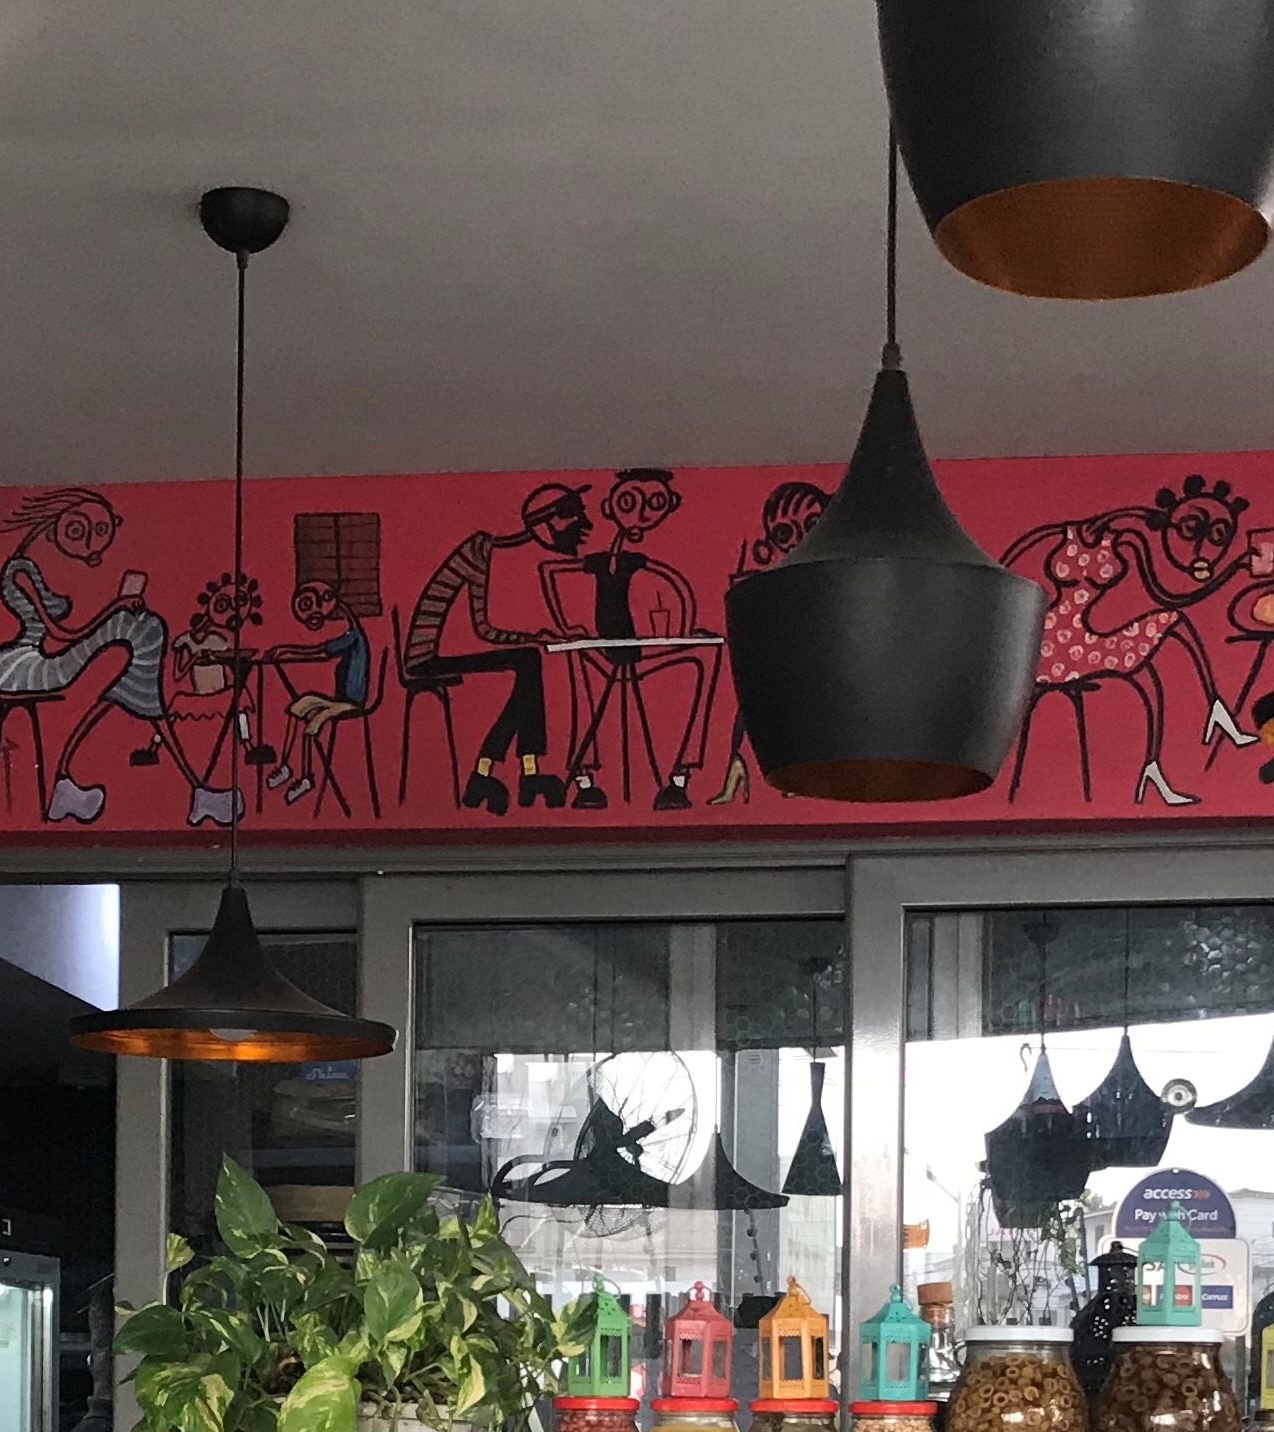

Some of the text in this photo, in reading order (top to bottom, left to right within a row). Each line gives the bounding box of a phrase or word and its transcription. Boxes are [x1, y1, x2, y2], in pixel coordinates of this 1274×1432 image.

[1143, 1188, 1193, 1200] access
[1134, 1209, 1218, 1223] Pay wh Card
